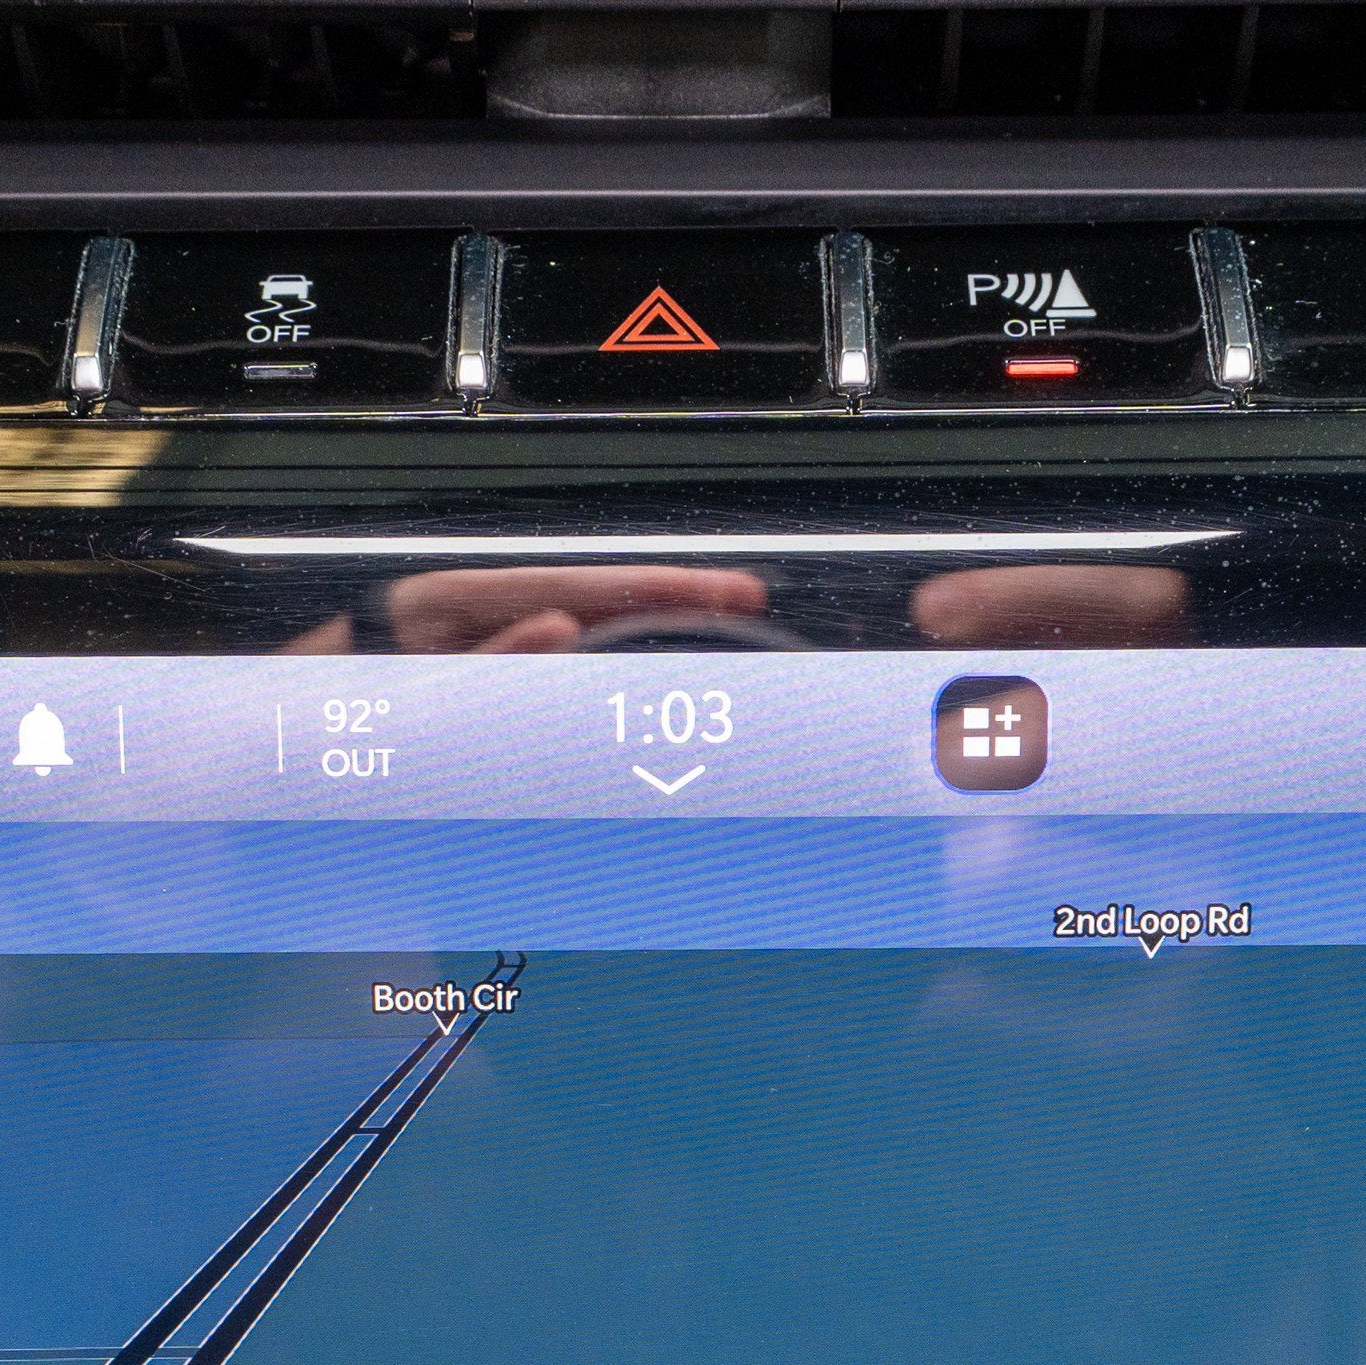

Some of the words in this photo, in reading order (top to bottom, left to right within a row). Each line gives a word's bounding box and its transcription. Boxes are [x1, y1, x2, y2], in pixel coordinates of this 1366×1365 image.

[246, 326, 311, 343] OFF
[1004, 319, 1066, 337] OFF
[322, 699, 390, 734] 92°
[606, 690, 734, 744] 1:03
[321, 748, 395, 778] OUT
[1055, 907, 1116, 934] 2nd
[1123, 906, 1202, 944] Loop
[1207, 905, 1249, 936] Rd
[373, 983, 464, 1014] Booth
[471, 983, 518, 1013] Cir
